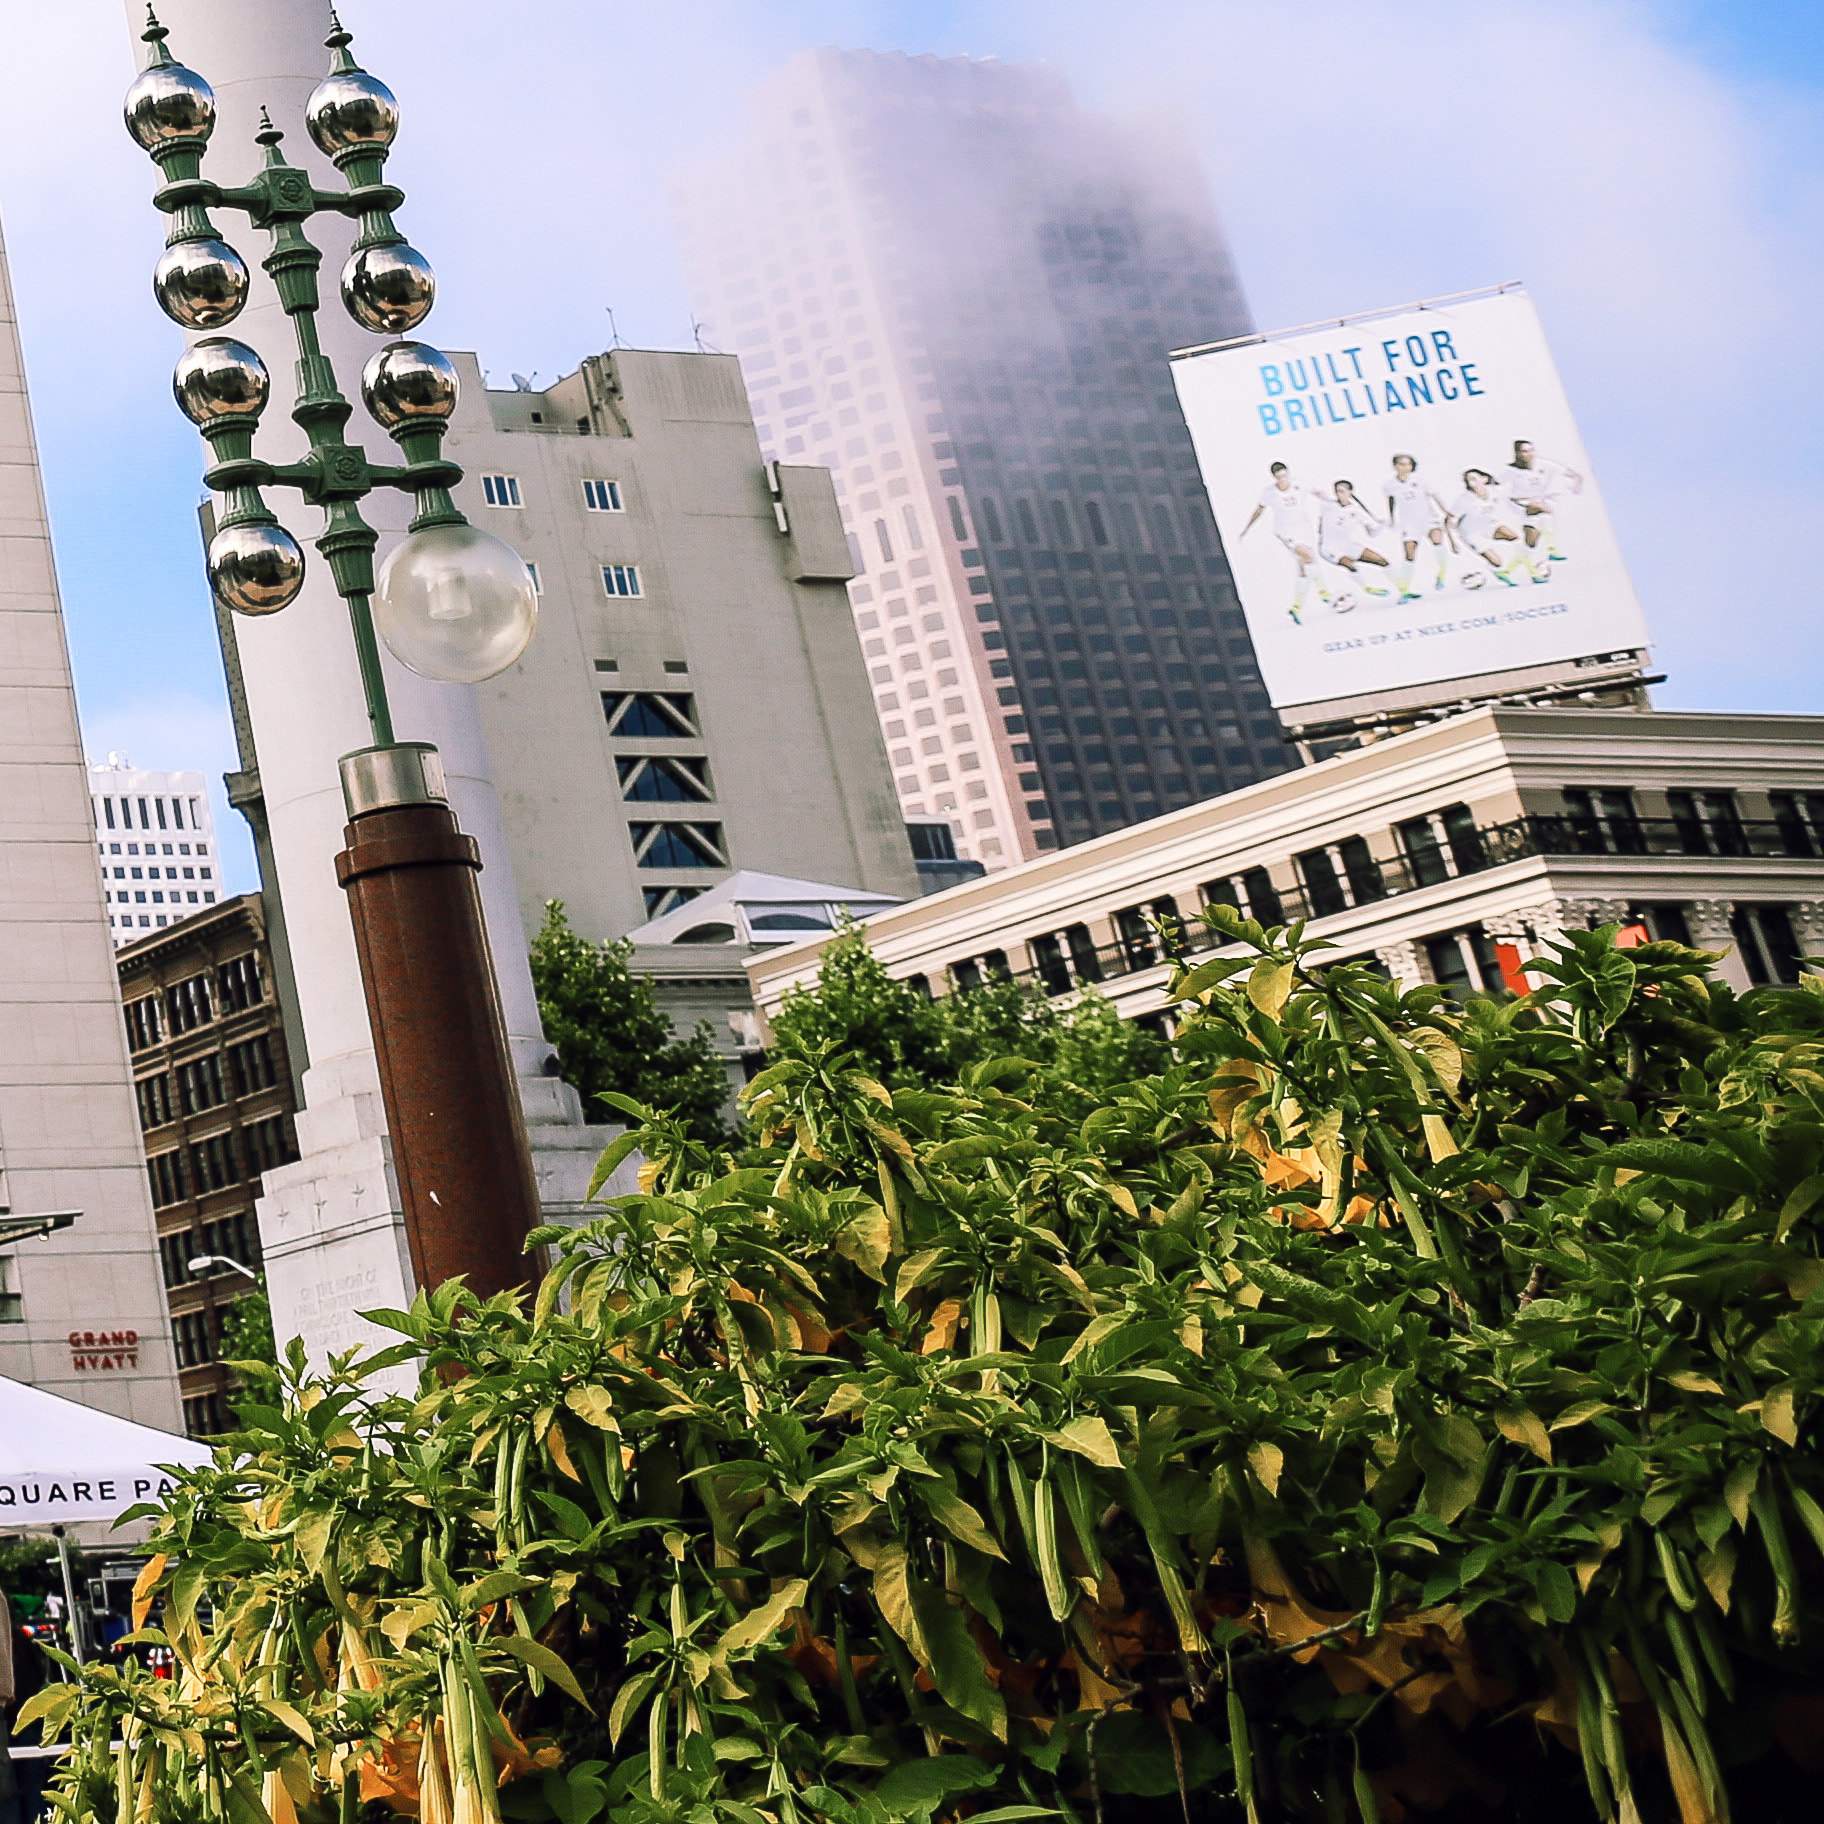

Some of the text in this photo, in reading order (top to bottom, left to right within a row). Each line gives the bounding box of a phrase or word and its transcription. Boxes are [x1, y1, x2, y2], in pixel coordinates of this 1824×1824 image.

[1258, 330, 1457, 396] BUILT FOR
[1257, 363, 1485, 436] BRILLIANCE
[69, 1330, 138, 1347] GRAND
[73, 1353, 138, 1370] HYATT
